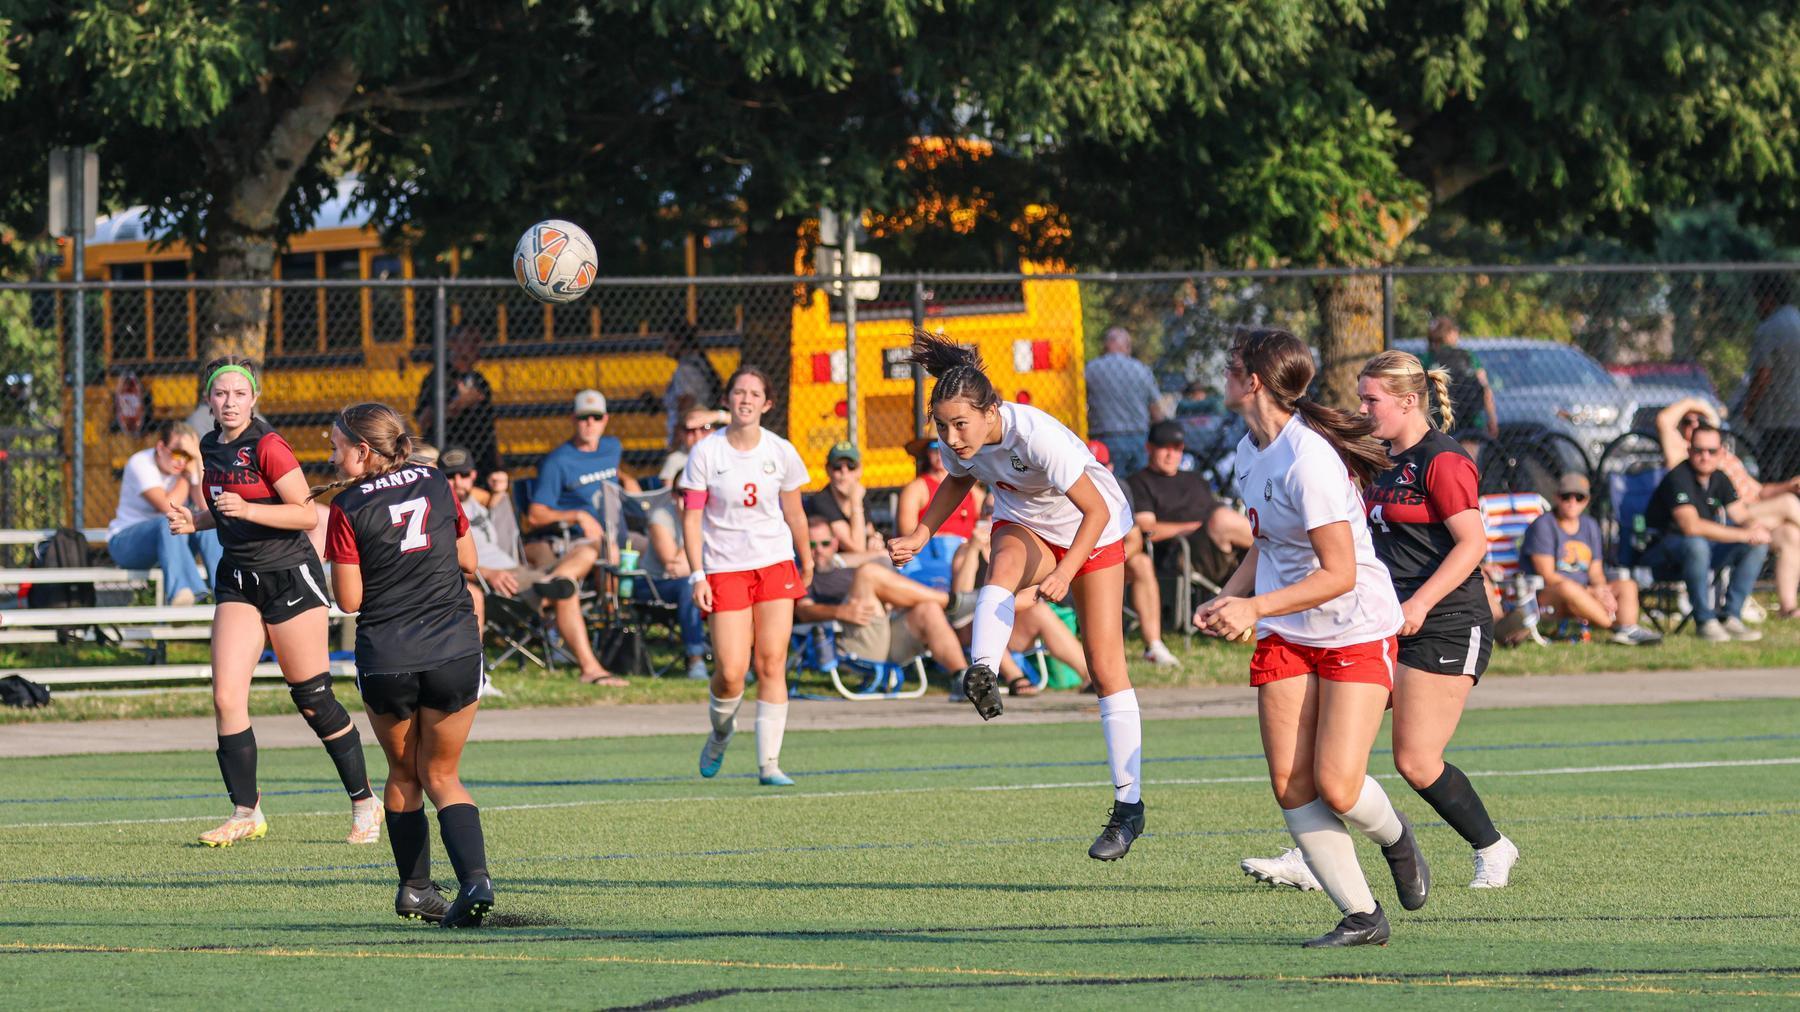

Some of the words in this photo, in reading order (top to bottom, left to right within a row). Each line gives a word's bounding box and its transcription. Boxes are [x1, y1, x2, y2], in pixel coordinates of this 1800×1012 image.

[360, 467, 431, 494] SANDY
[743, 483, 757, 507] 3
[388, 496, 431, 553] 7
